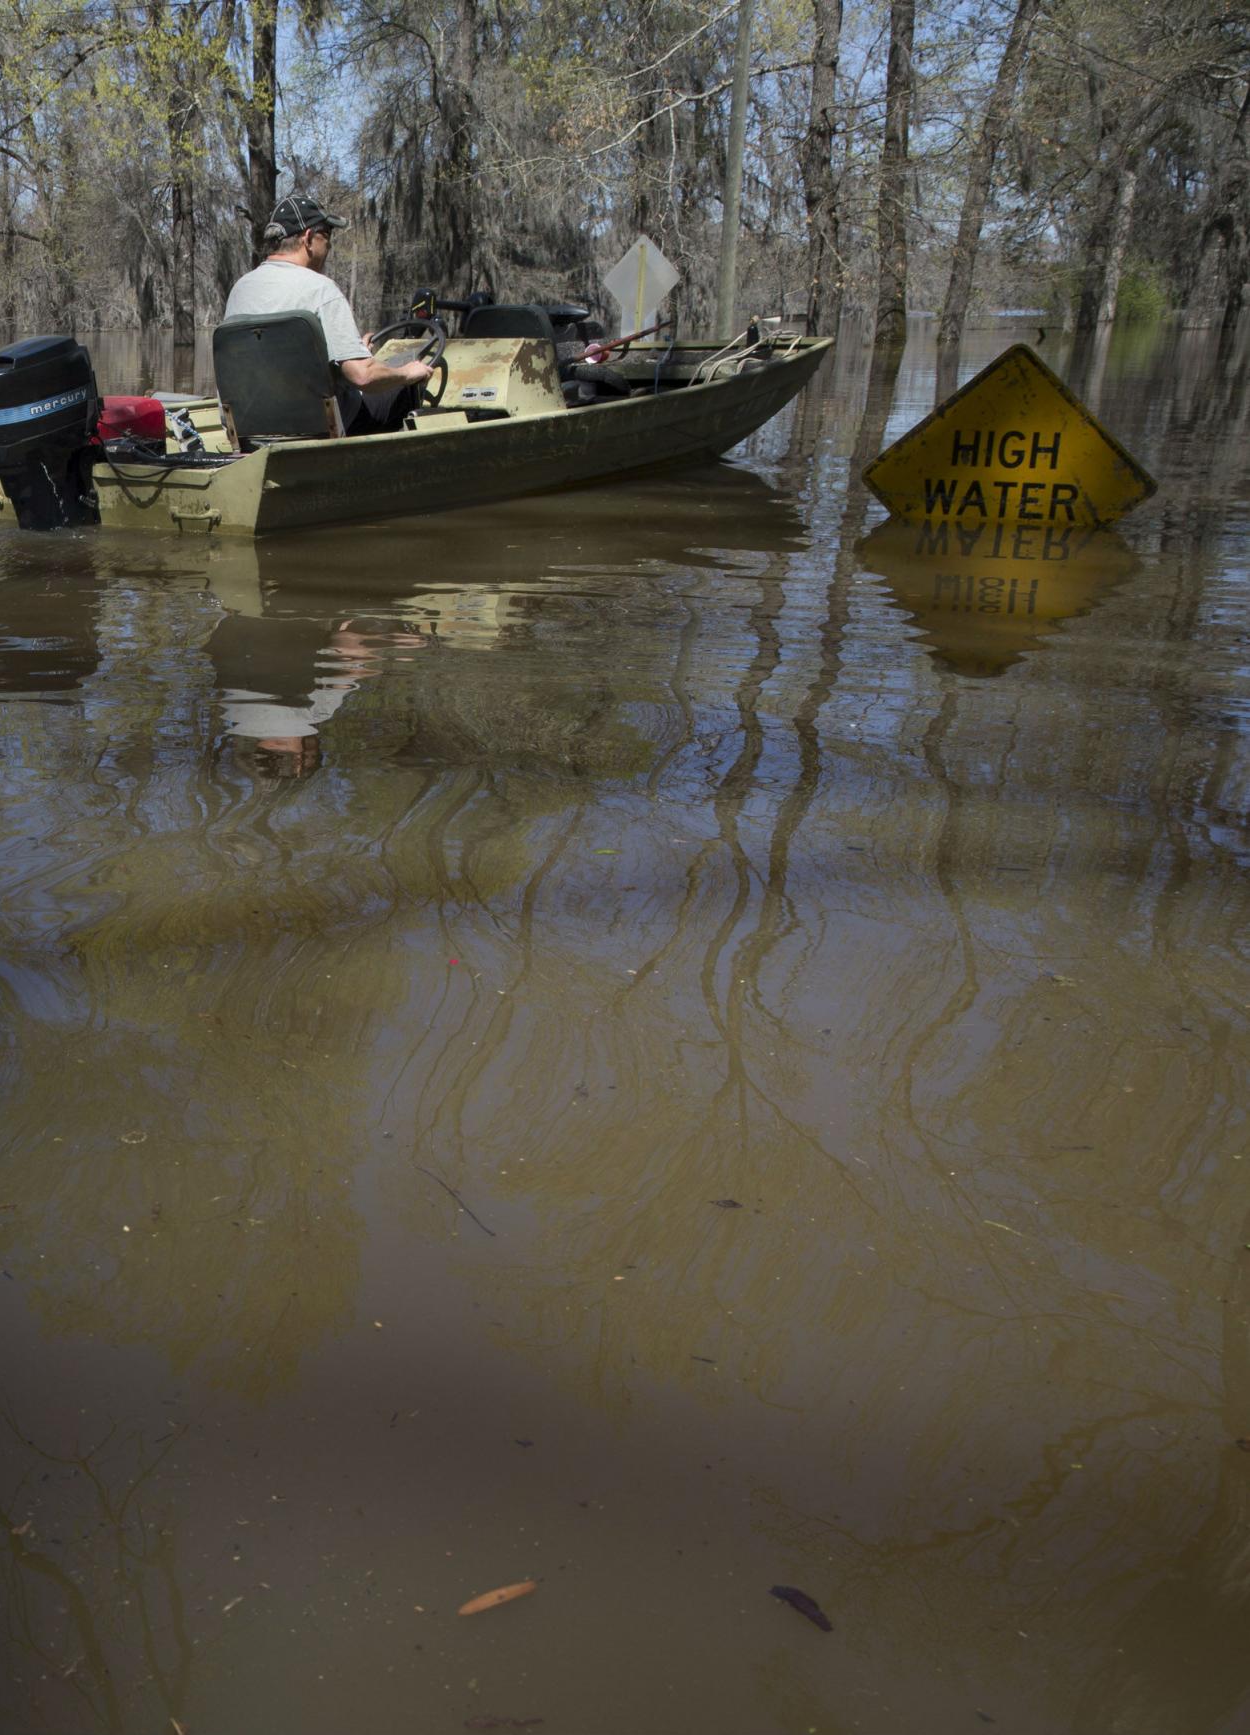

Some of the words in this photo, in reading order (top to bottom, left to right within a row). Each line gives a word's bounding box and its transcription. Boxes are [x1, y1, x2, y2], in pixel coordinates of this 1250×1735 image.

[30, 389, 87, 415] mercury
[951, 430, 1061, 470] HIGH
[924, 479, 1079, 521] WATER
